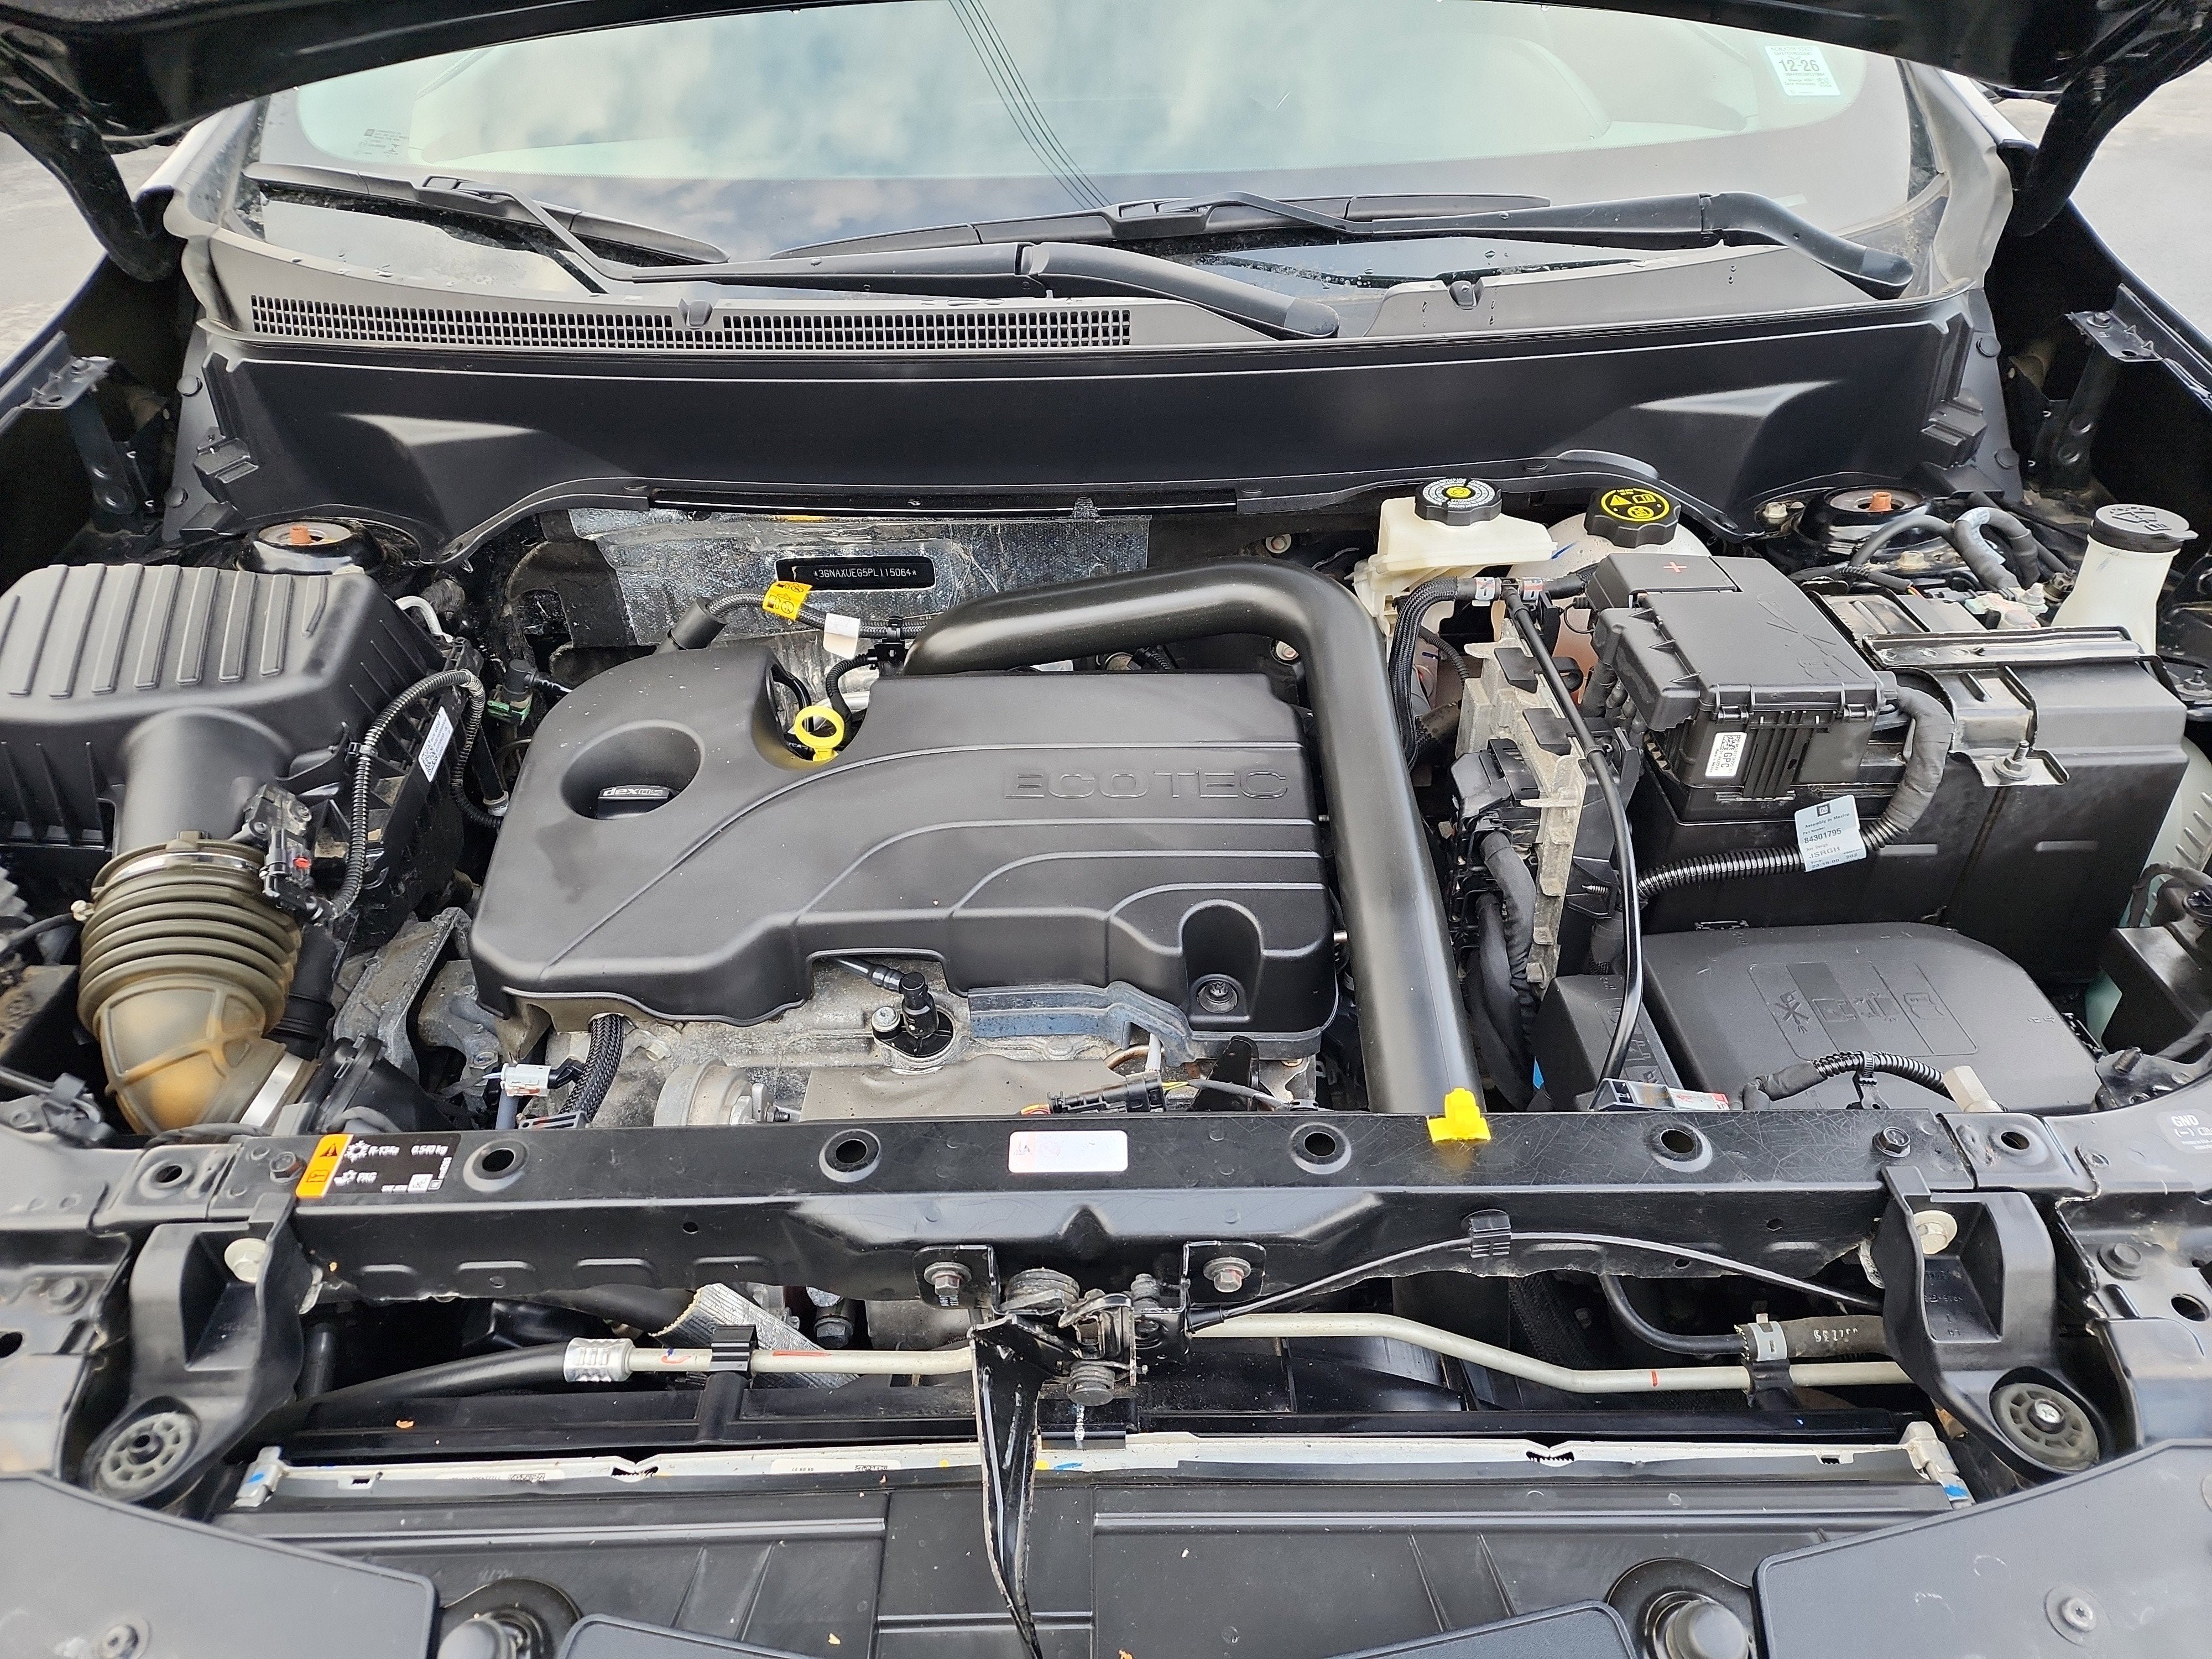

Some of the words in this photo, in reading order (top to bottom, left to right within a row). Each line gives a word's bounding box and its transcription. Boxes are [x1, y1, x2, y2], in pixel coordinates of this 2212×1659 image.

[1721, 753, 1733, 768] GPC
[1004, 769, 1288, 799] ECOTEC
[1805, 820, 1827, 828] Assembly
[1804, 828, 1841, 844] 84301795
[1809, 846, 1840, 859] JSRGH
[2171, 1114, 2199, 1127] GND
